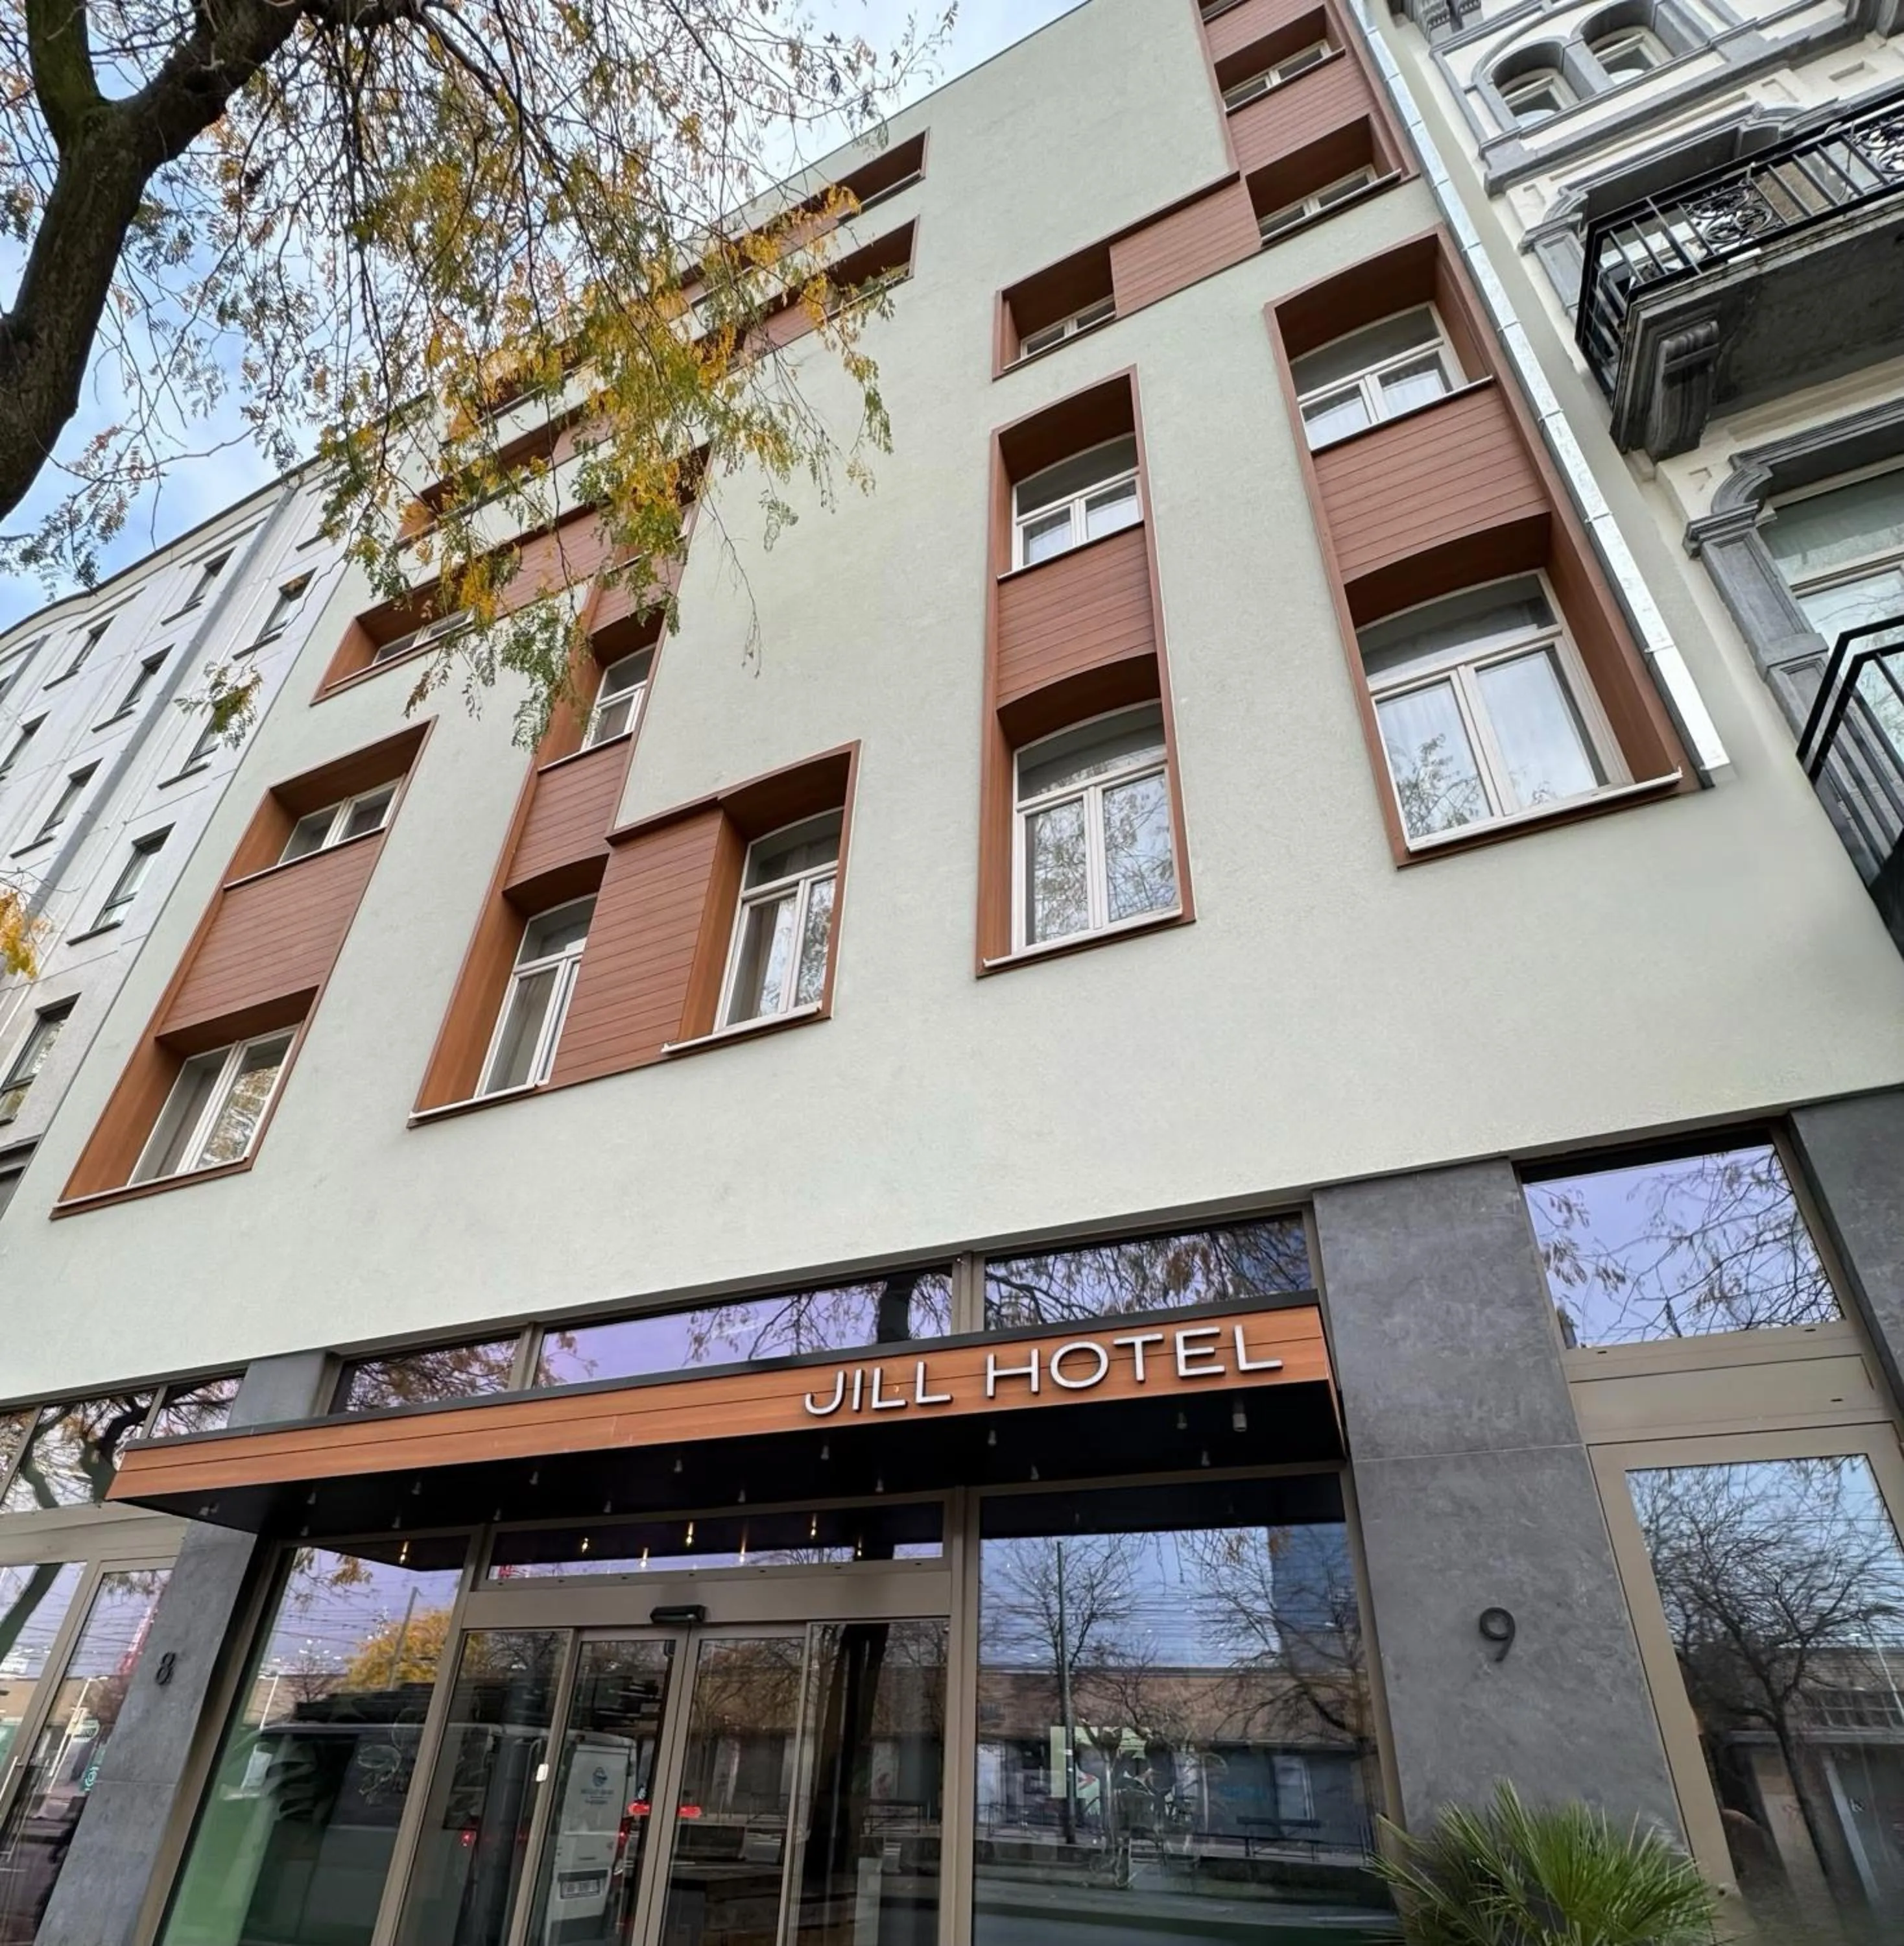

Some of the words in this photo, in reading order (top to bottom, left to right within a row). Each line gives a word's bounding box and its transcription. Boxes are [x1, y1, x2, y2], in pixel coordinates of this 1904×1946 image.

[804, 1360, 953, 1416] JILL
[985, 1323, 1284, 1398] HOTEL
[1479, 1607, 1516, 1663] 9
[155, 1652, 176, 1686] 8
